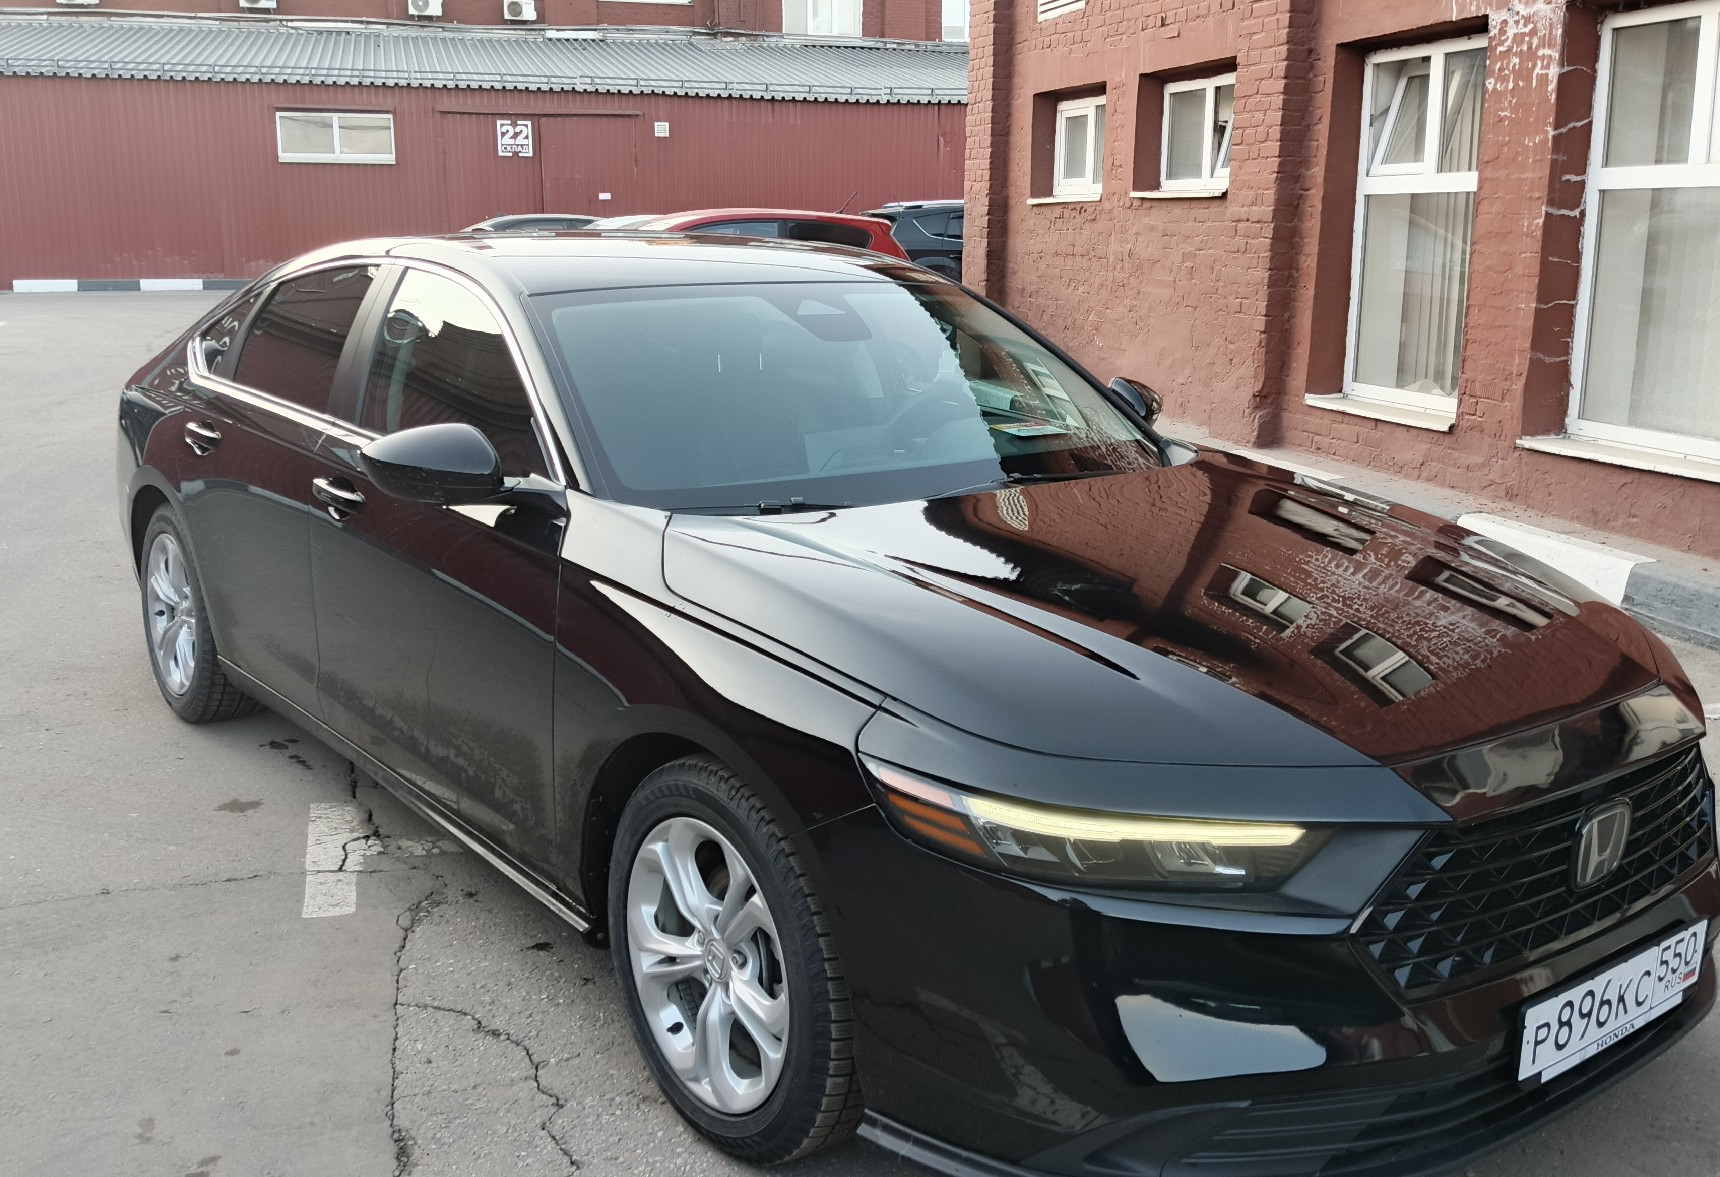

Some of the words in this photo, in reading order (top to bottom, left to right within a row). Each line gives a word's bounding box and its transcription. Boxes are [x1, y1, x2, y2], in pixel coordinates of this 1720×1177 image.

[501, 125, 529, 145] 22
[502, 145, 529, 153] СКЛАД
[1657, 930, 1698, 983] 550
[1663, 971, 1683, 993] RUS
[1596, 1022, 1636, 1050] HONDA
